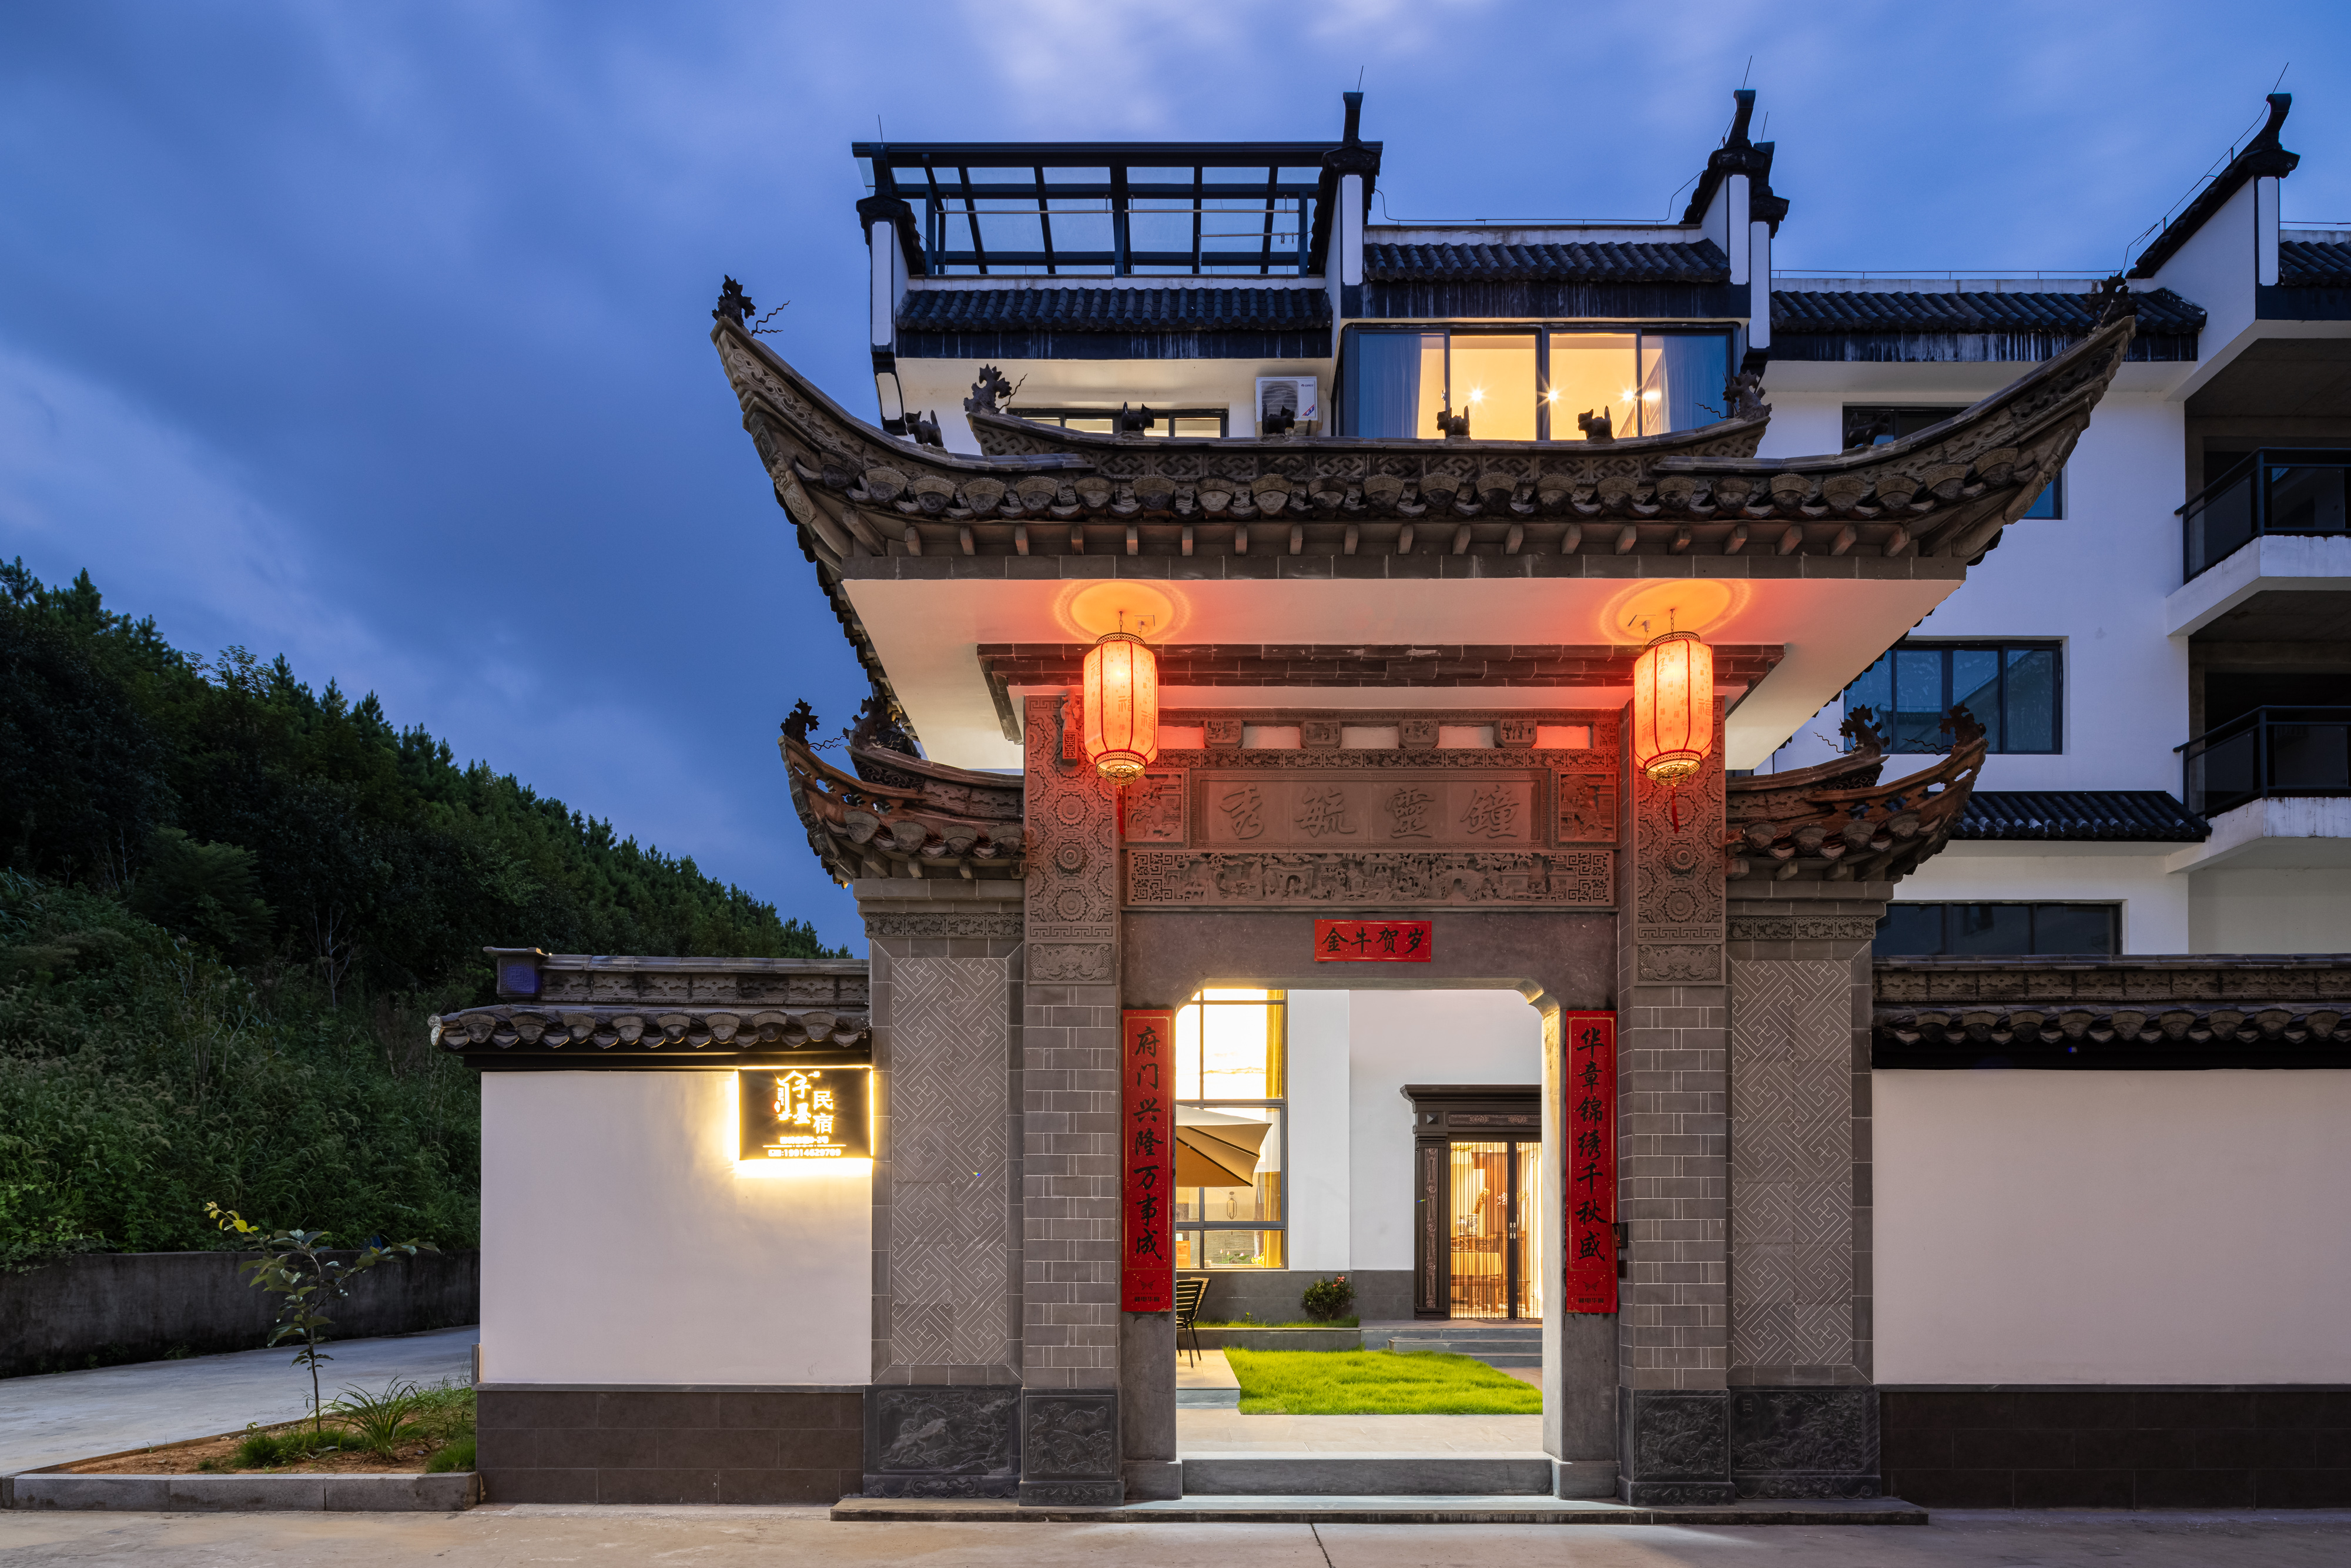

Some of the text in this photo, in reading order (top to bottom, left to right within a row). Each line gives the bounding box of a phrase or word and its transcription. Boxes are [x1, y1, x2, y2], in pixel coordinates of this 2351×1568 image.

[1699, 698, 1712, 716] 福
[1142, 711, 1155, 731] 福
[1642, 719, 1655, 742] 福
[1321, 927, 1425, 954] 金牛贺岁
[812, 1090, 834, 1134] 民宿
[1133, 1026, 1163, 1261] 府门兴隆万事成
[1575, 1027, 1607, 1262] 华章锦绣千秋盛
